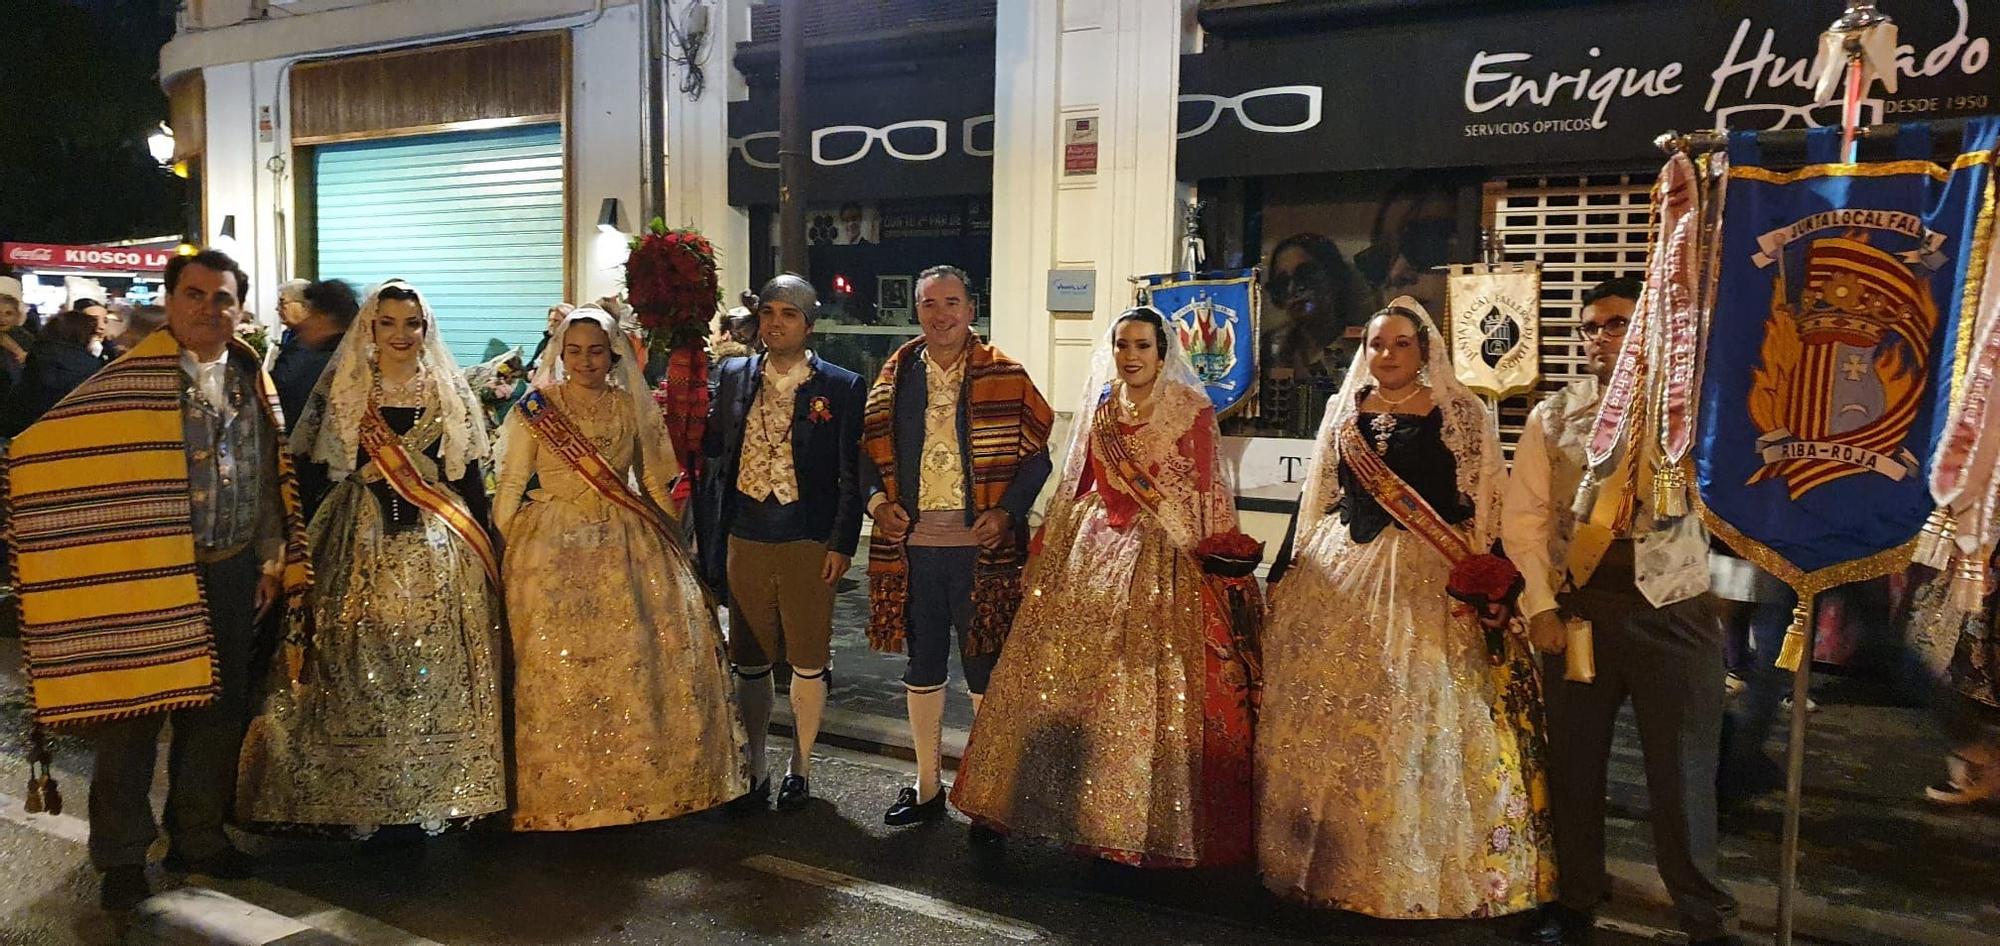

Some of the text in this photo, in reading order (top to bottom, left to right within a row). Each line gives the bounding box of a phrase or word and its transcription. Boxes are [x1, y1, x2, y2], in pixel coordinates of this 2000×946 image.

[1465, 47, 1683, 129] Enrique
[1885, 95, 1988, 113] DESDE 1950
[1464, 123, 1530, 137] SERVICIOS
[1792, 213, 1829, 238] JUNTA
[1832, 211, 1883, 227] LOCAL
[65, 250, 168, 266] KIOSCO LA
[1781, 443, 1878, 469] RIBA-ROJA
